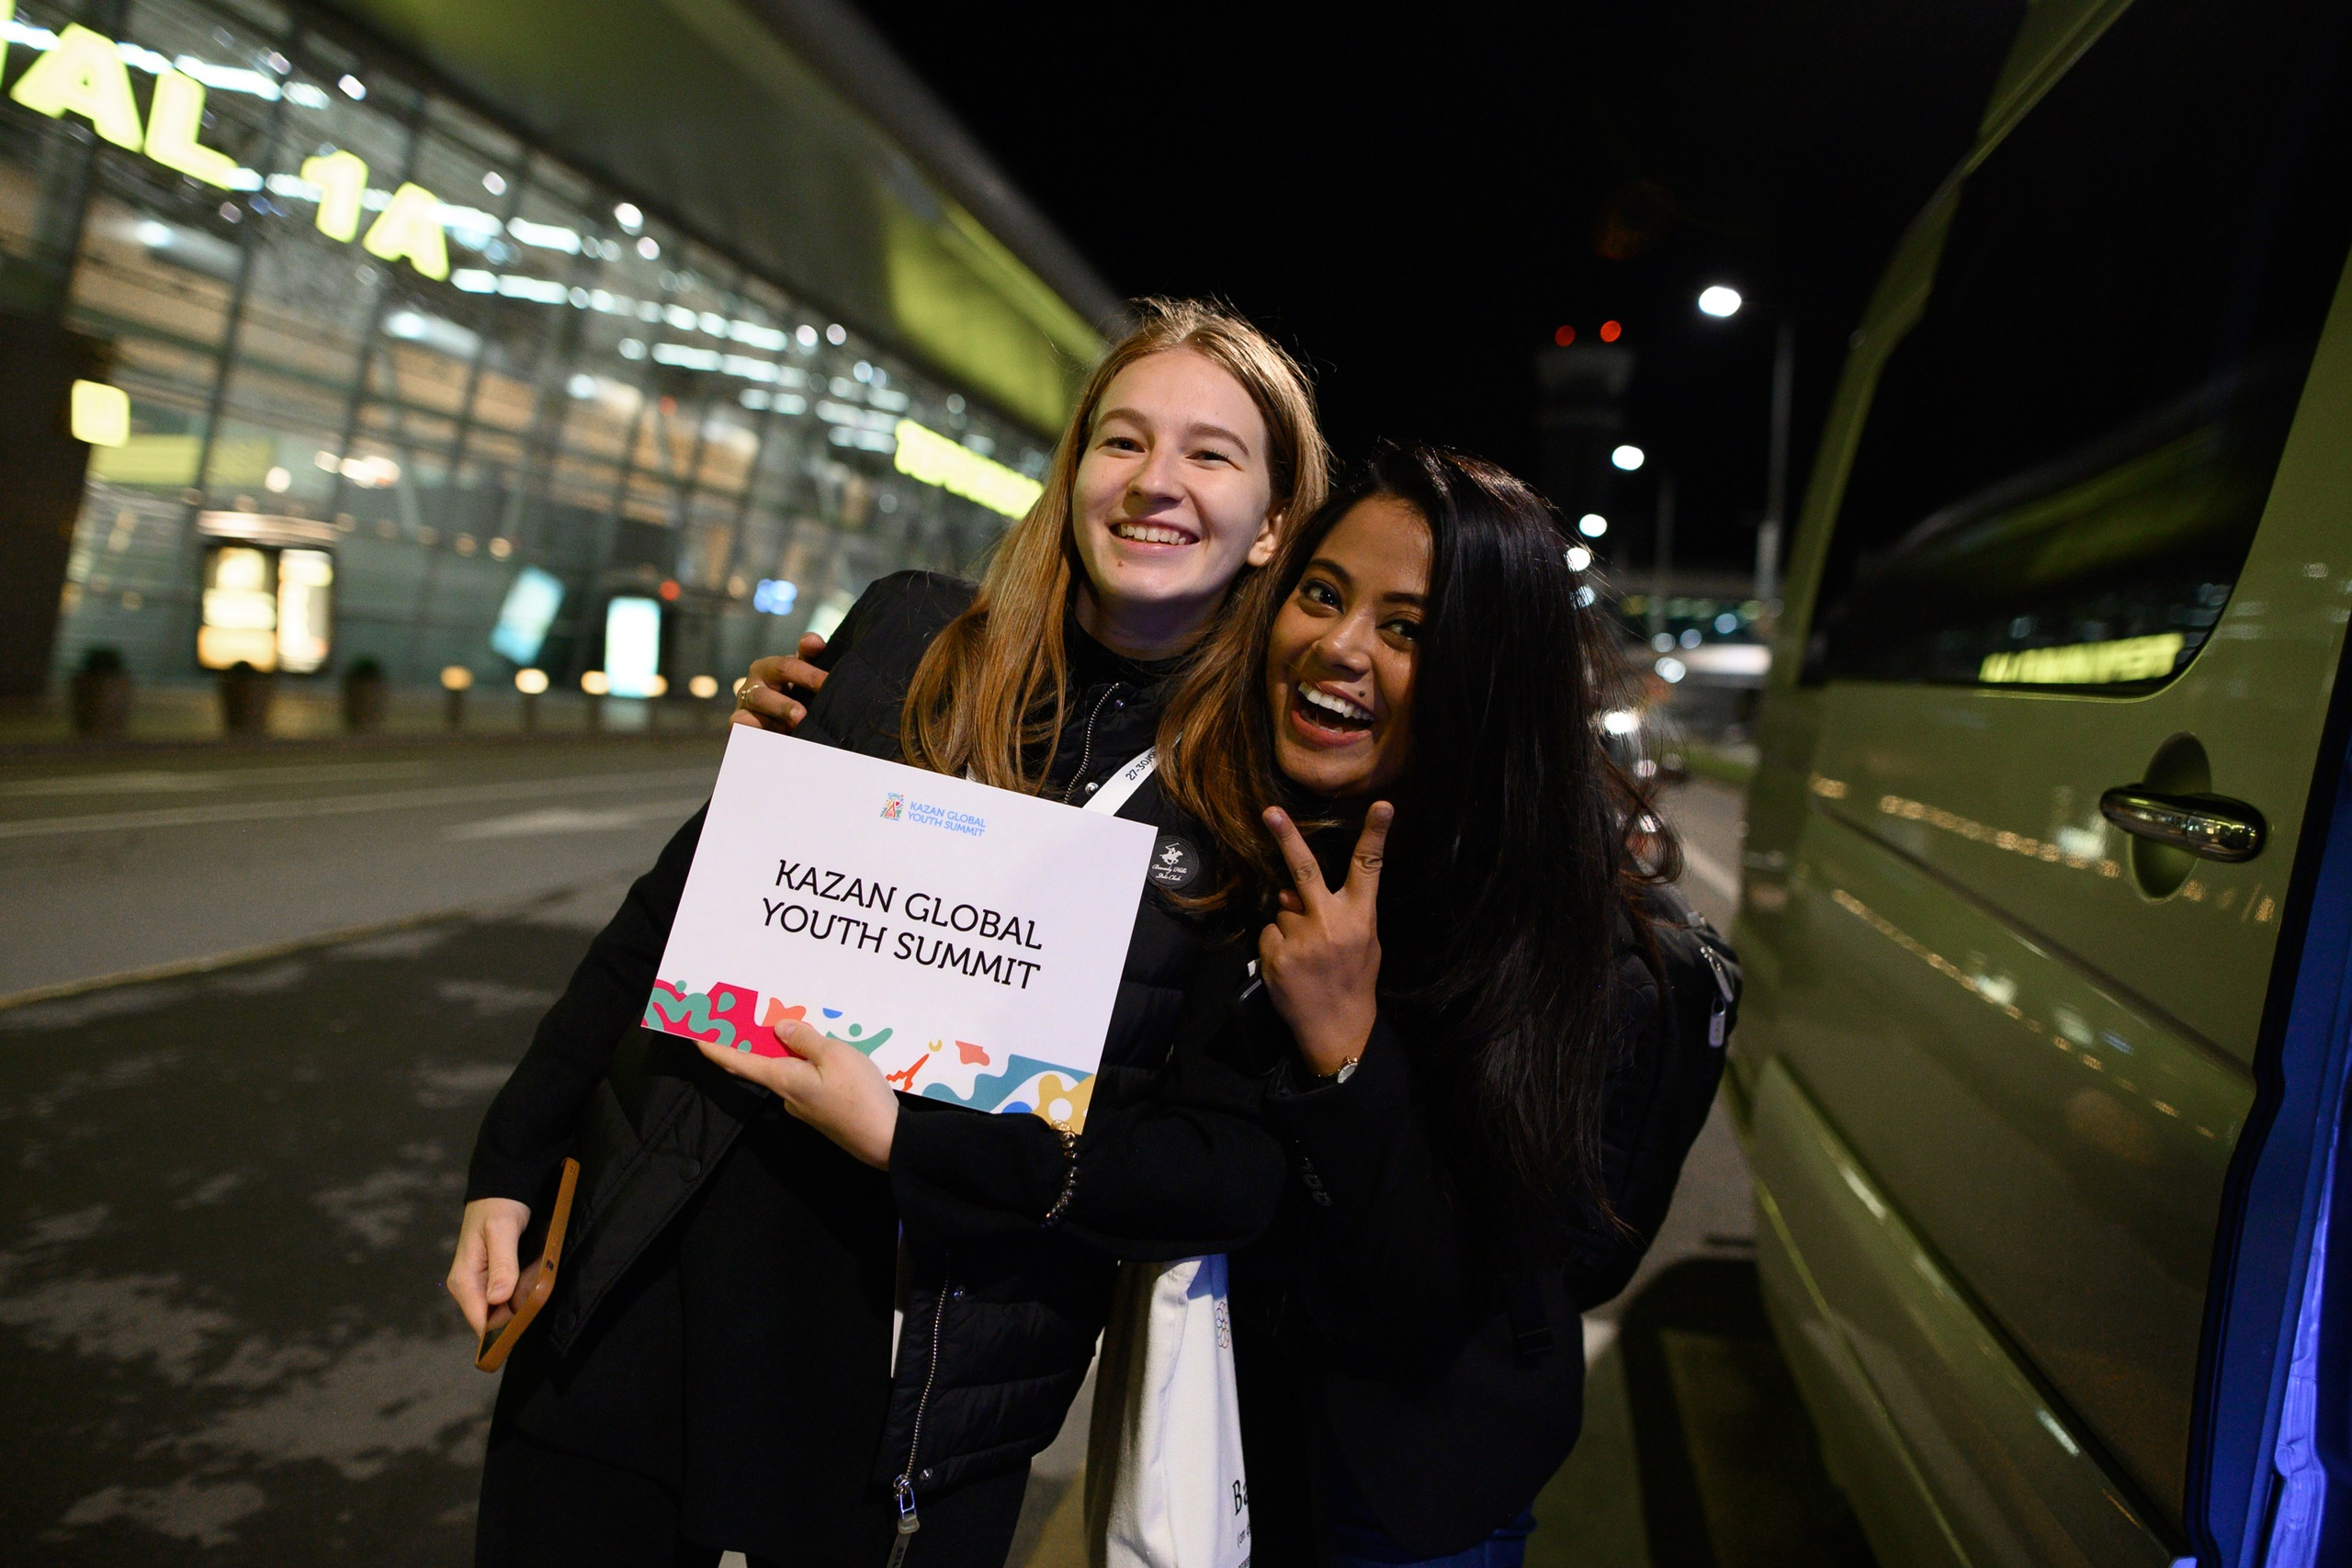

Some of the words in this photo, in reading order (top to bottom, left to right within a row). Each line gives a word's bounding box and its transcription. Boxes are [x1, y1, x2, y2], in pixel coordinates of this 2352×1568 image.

[0, 0, 242, 190] AL
[300, 149, 450, 282] 1A
[908, 811, 943, 828] YOUTH
[944, 820, 985, 838] SUMMIT
[910, 801, 945, 818] KAZAN
[946, 810, 986, 829] GLOBAL
[762, 897, 888, 953] YOUTH
[893, 931, 1042, 990] SUMMIT
[775, 859, 898, 913] KAZAN
[904, 892, 1043, 951] GLOBAL
